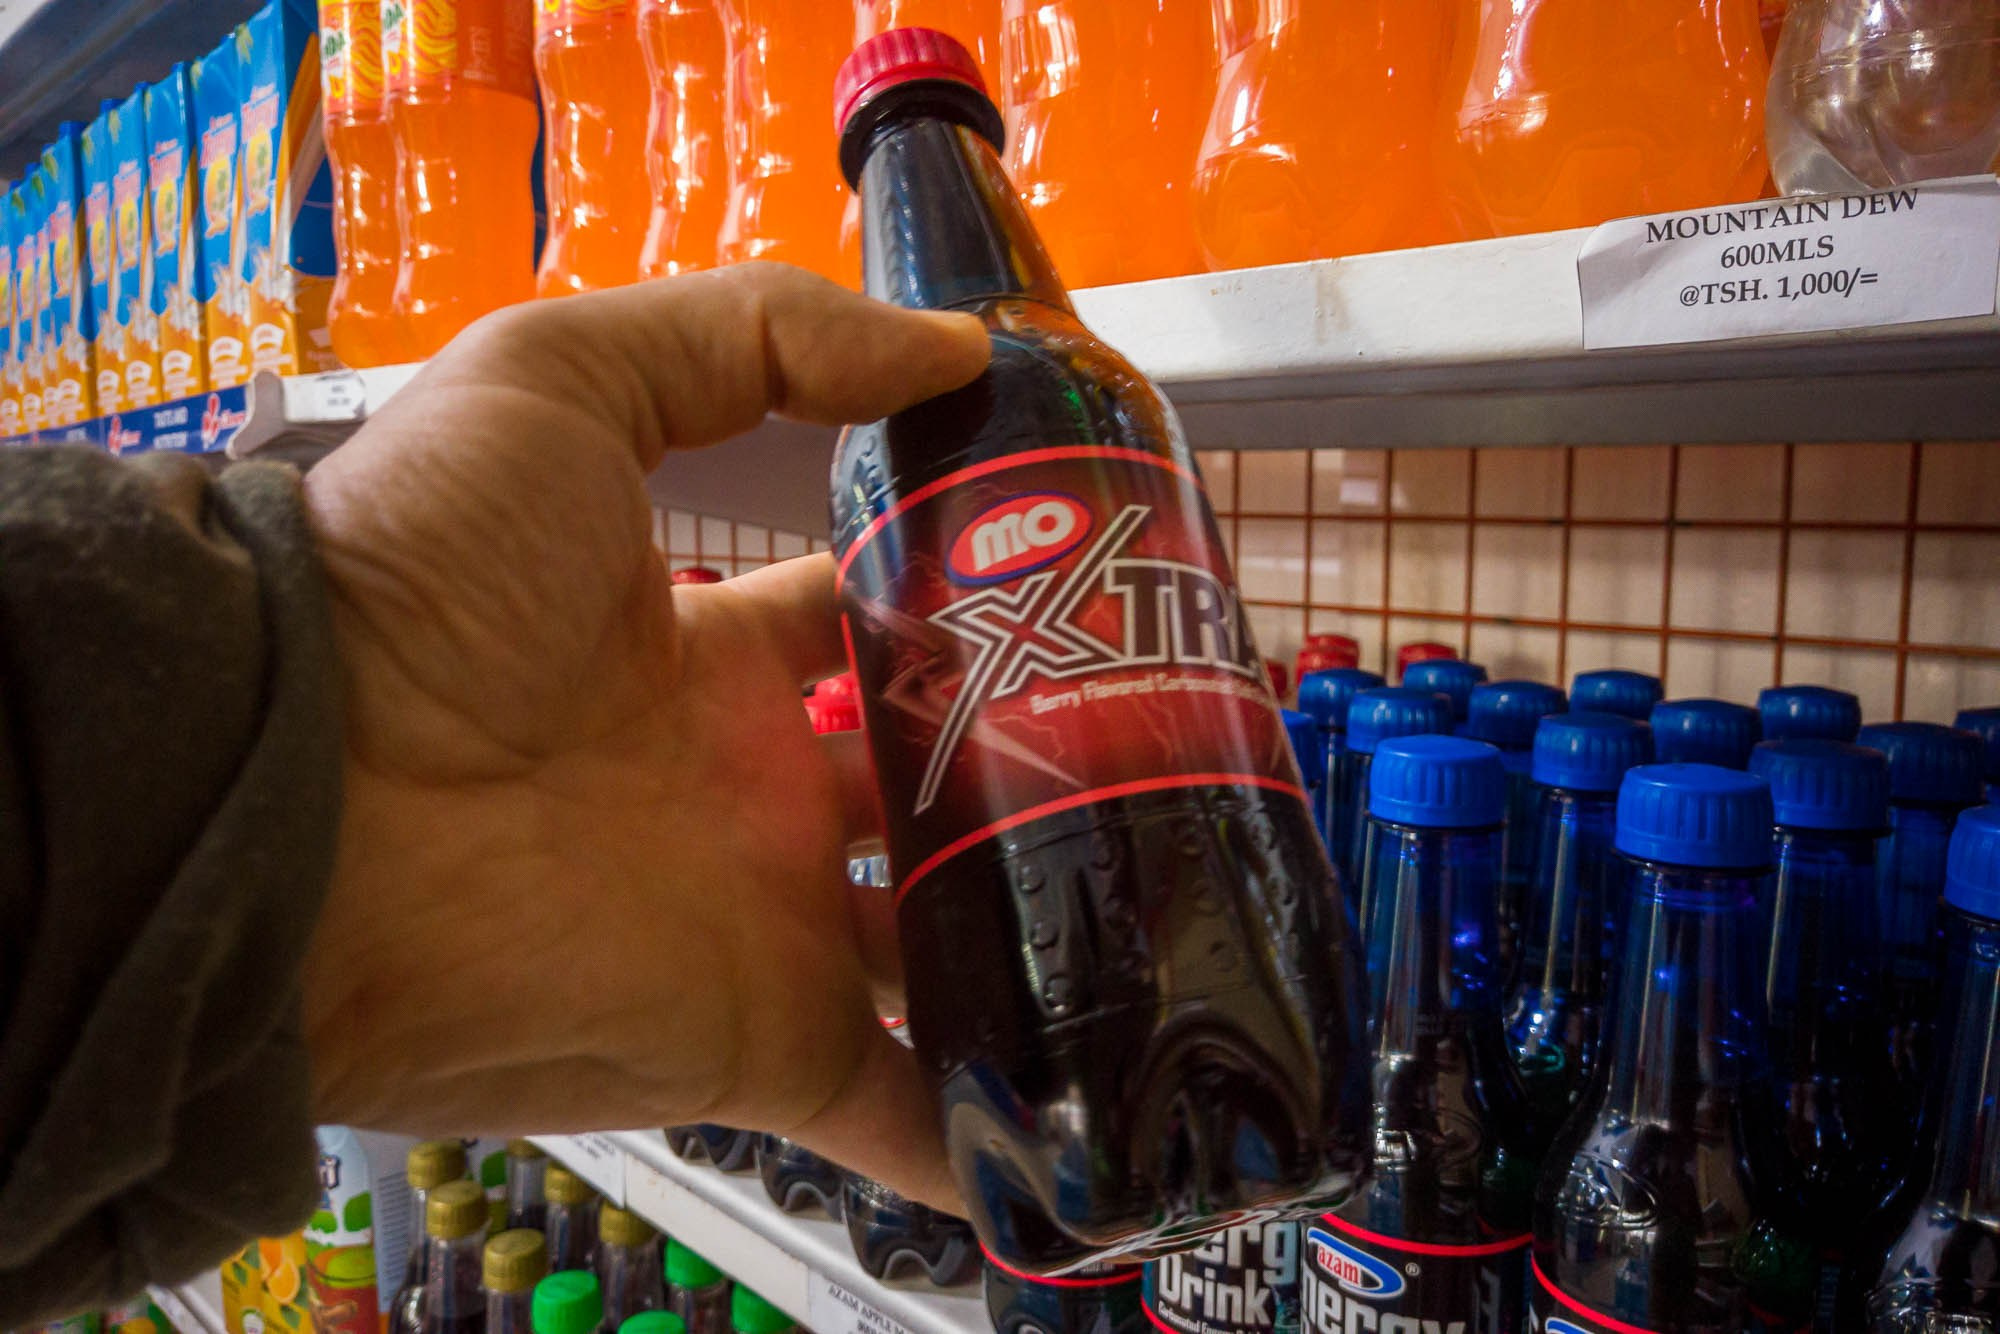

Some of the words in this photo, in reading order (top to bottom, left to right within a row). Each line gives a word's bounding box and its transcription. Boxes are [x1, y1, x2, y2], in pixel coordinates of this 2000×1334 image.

[1645, 200, 1829, 244] MOUNTAIN
[1841, 187, 1919, 219] DEW
[1720, 235, 1835, 269] 600MLS
[1679, 278, 1769, 307] @TSH.
[1777, 267, 1879, 302] 1,000/=
[915, 503, 1266, 816] XTR
[1158, 1253, 1272, 1326] Drink
[1316, 1244, 1361, 1286] azam
